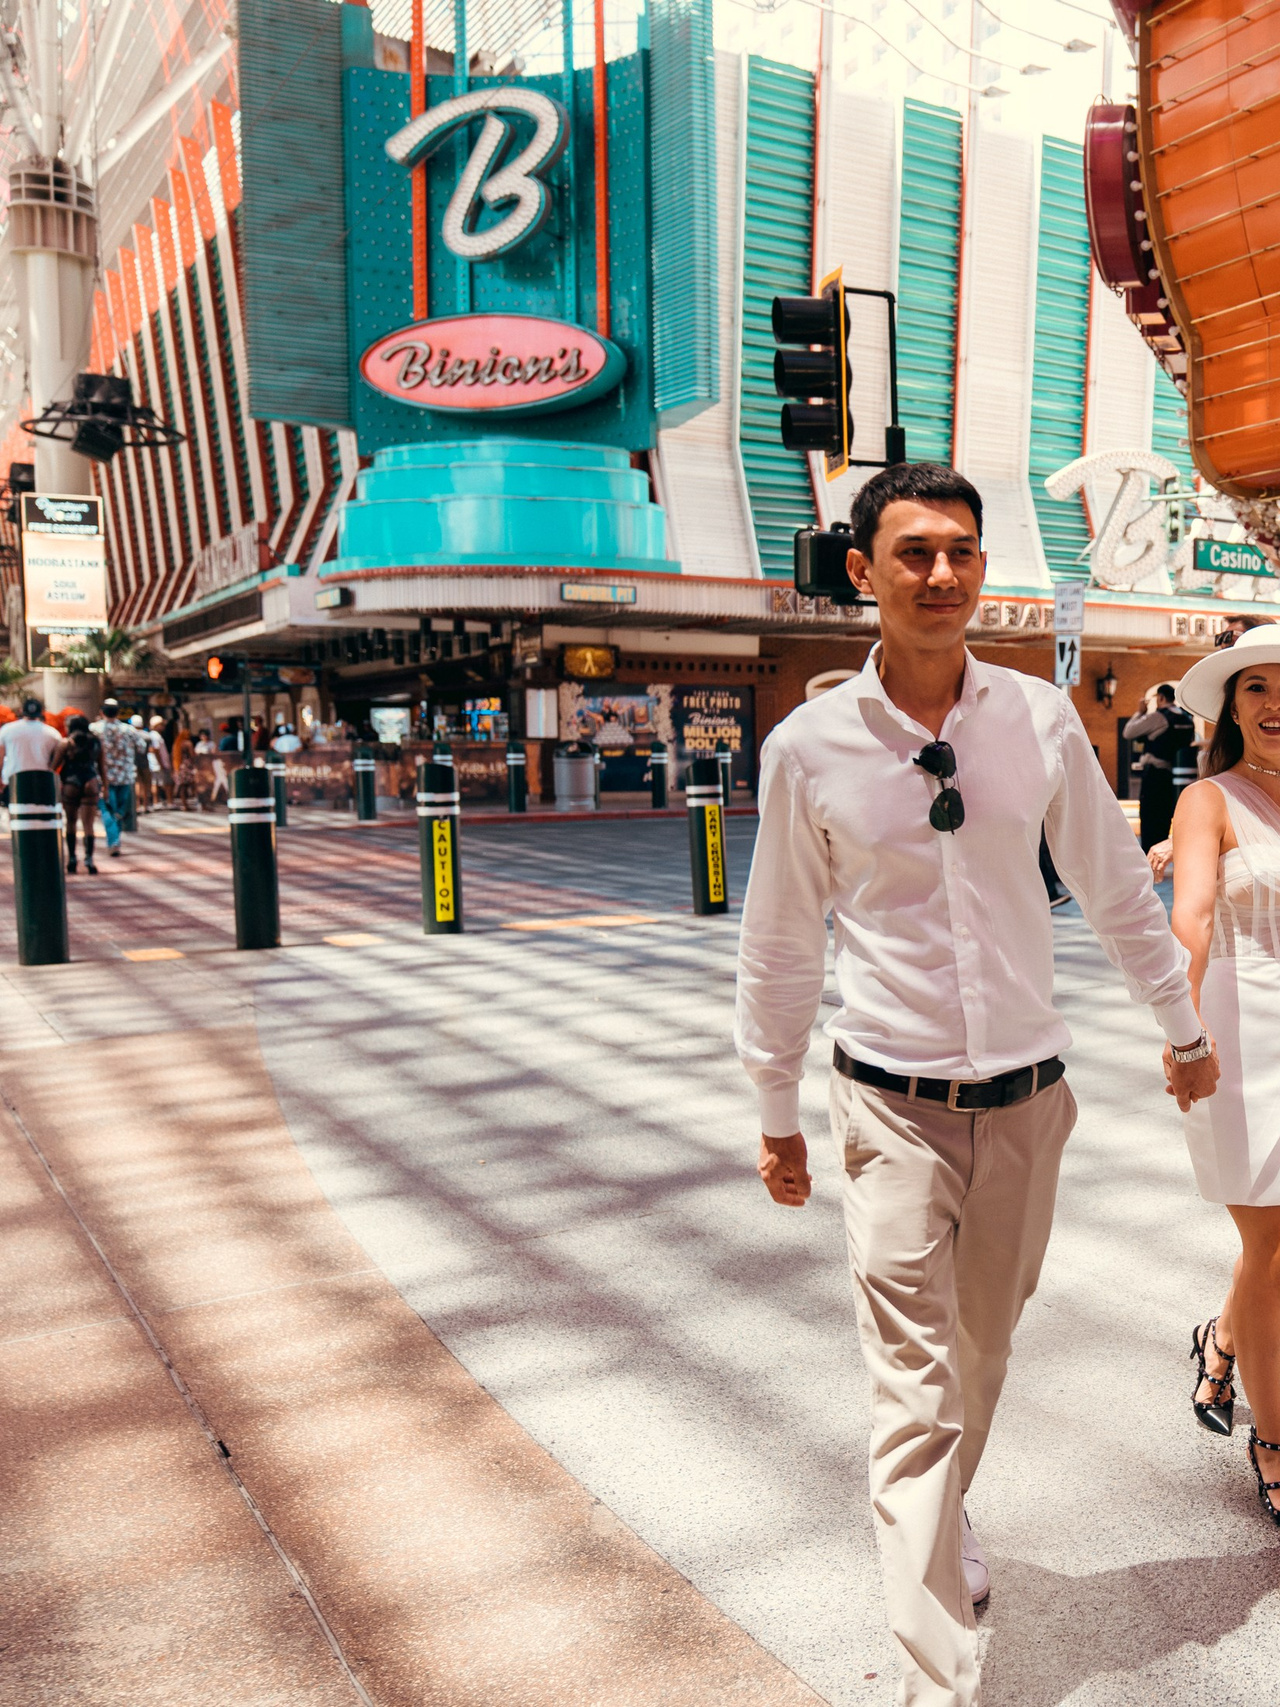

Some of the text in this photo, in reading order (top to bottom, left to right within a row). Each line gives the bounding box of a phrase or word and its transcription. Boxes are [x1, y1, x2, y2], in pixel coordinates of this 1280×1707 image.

[384, 86, 567, 261] B
[380, 340, 589, 390] Binion's
[1210, 544, 1261, 571] Casino
[617, 587, 634, 602] PIT
[979, 601, 1056, 629] CRAP
[683, 696, 741, 709] FREE PHOTO
[683, 725, 742, 739] MILLION
[688, 711, 736, 726] Binion's
[708, 809, 718, 837] CART
[437, 820, 451, 912] CAUTION
[711, 841, 722, 897] CROSSING
